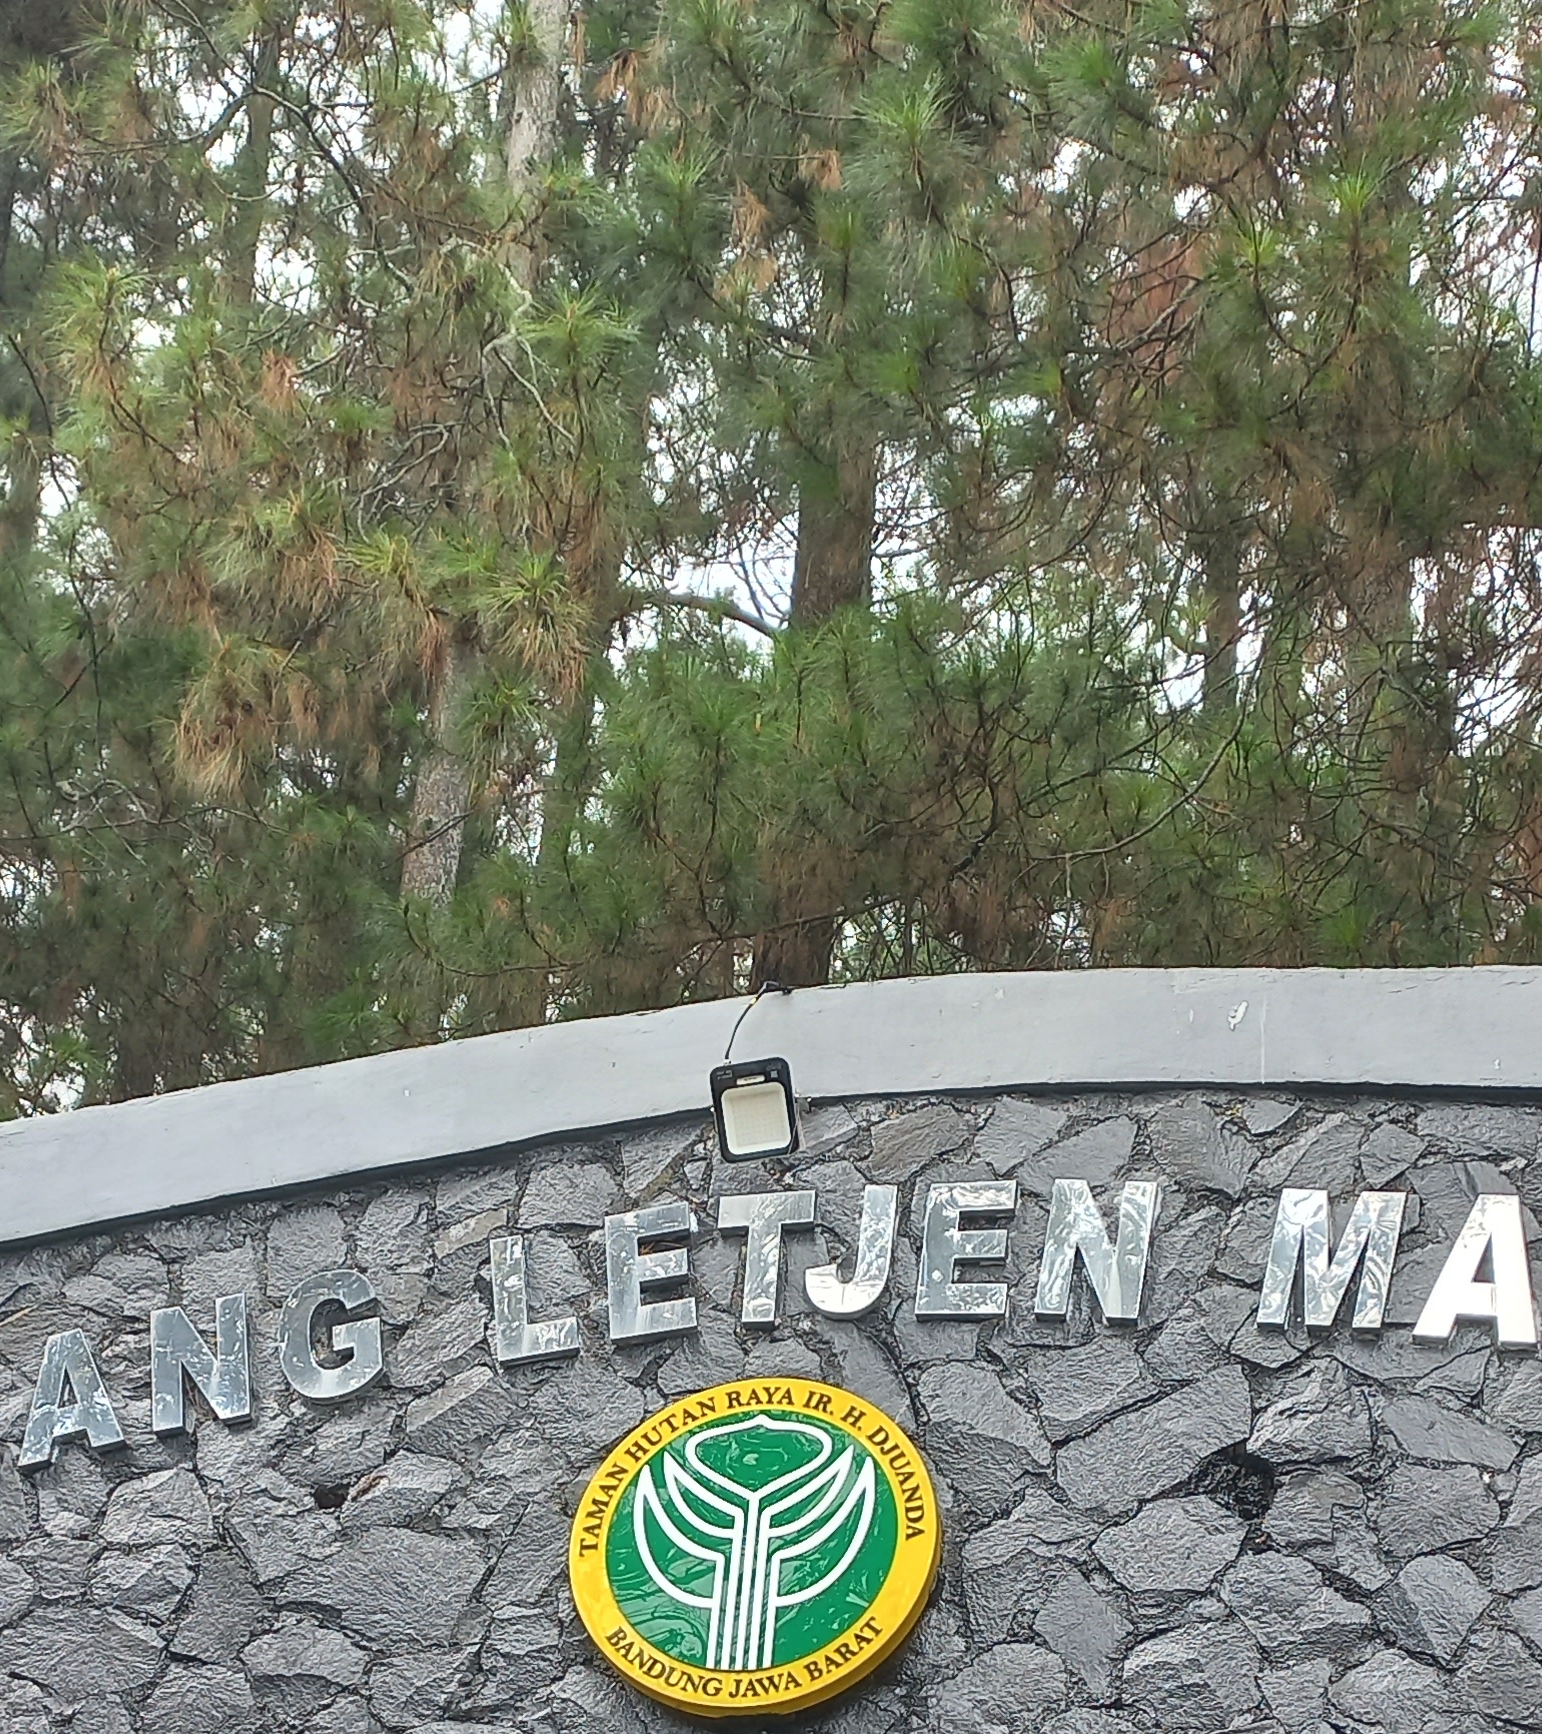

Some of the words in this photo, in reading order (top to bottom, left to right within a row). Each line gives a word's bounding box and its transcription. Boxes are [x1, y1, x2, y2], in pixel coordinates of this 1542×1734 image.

[489, 1177, 1163, 1369] LETJEN
[579, 1462, 630, 1557] TAMAN
[624, 1397, 717, 1463] HUTAN
[726, 1387, 795, 1409] RAYA
[802, 1390, 835, 1414] IR.
[840, 1407, 867, 1432] H.
[866, 1425, 925, 1541] DJUANDA
[605, 1626, 723, 1697] BANDUNG
[728, 1677, 802, 1699] JAWA
[804, 1616, 883, 1681] BARAT
